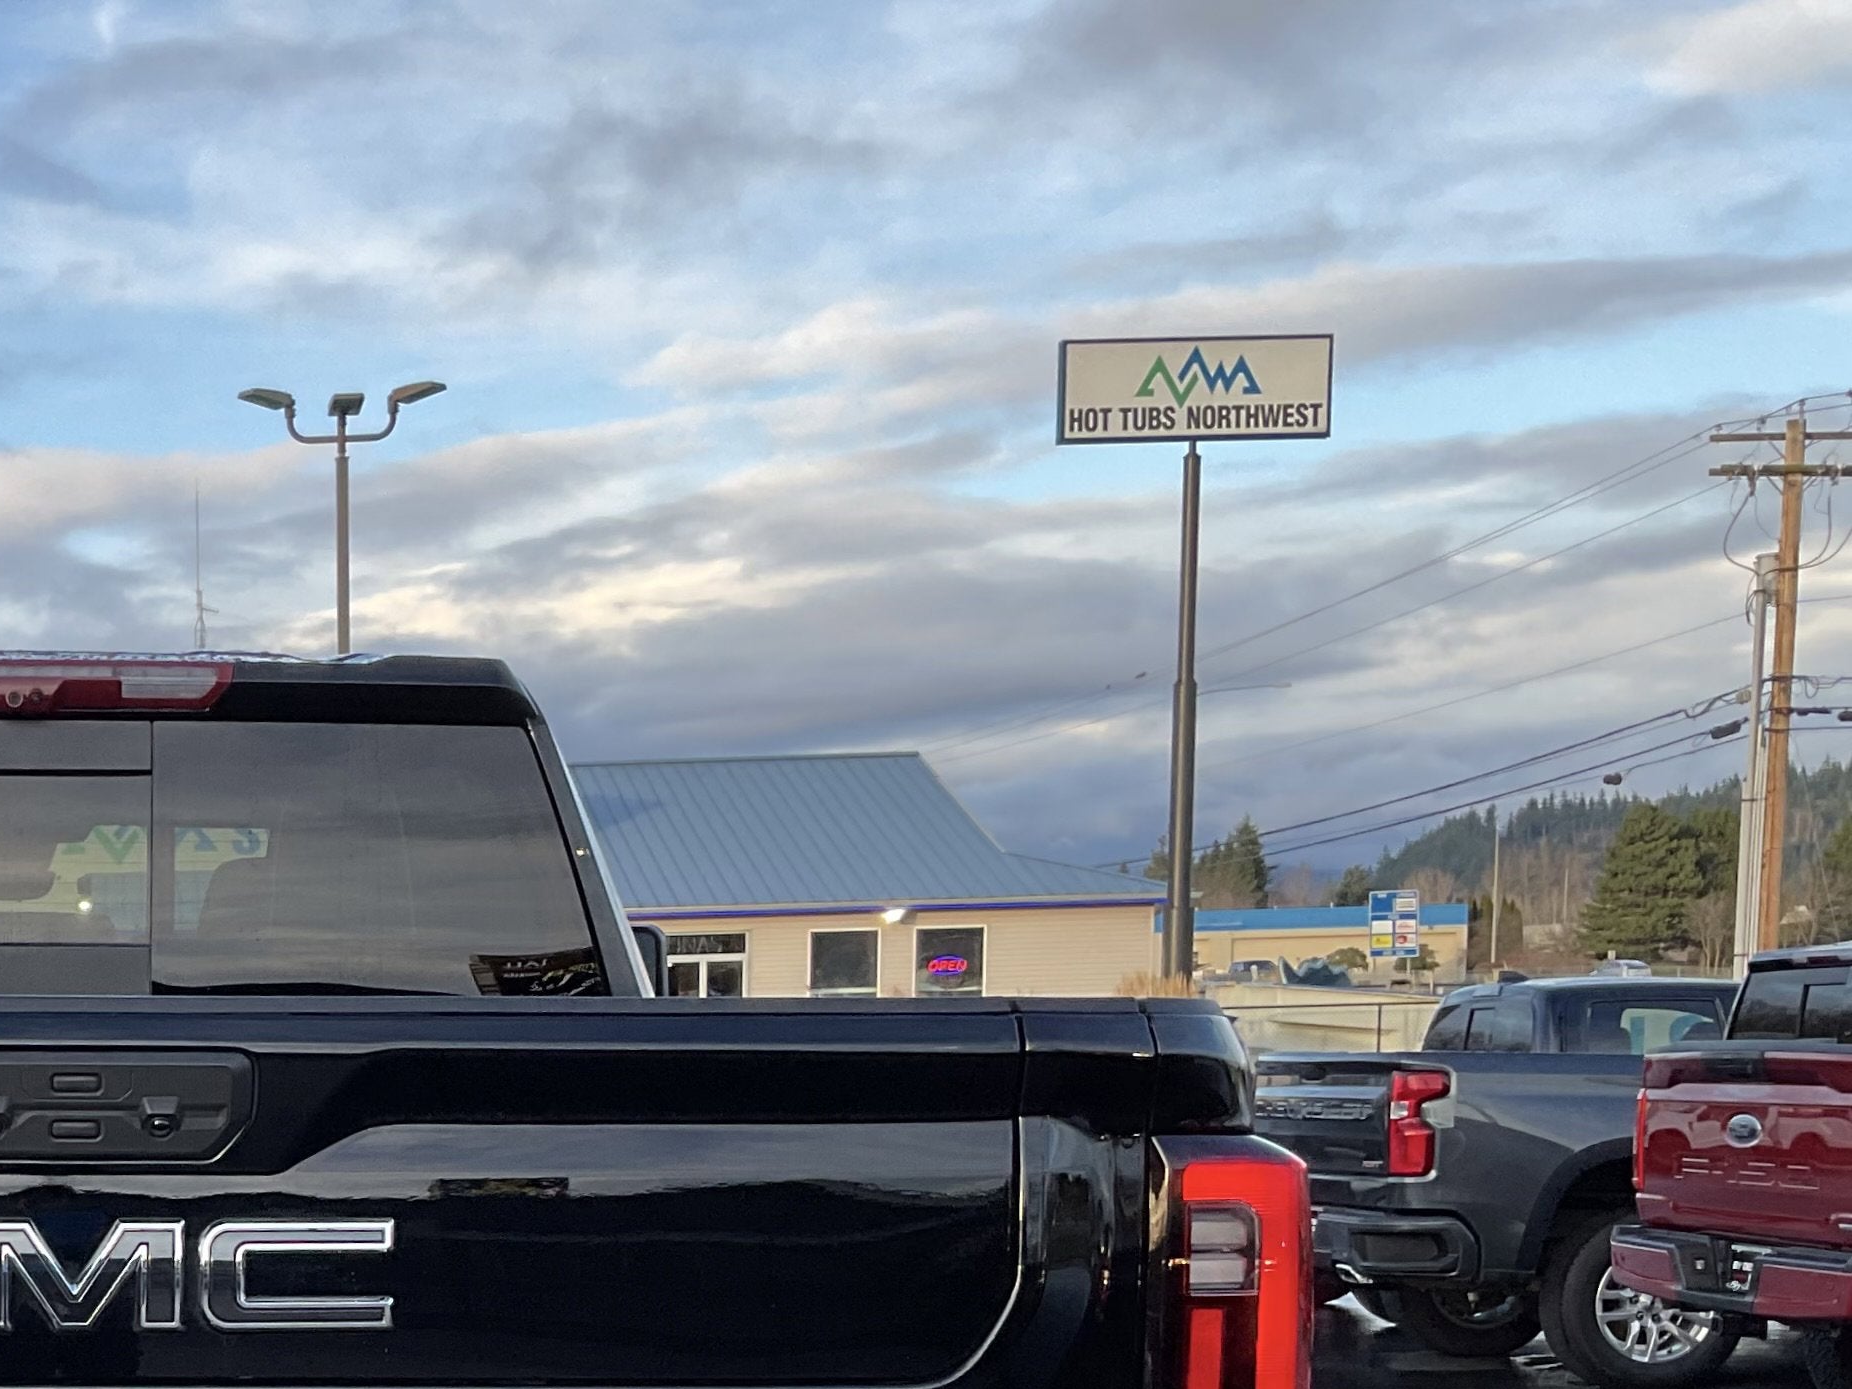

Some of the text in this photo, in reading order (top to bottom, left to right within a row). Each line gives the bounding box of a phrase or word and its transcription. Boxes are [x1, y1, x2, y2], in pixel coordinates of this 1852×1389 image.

[1069, 403, 1323, 432] HOT TUBS NORTHWEST
[927, 958, 968, 972] OPEN
